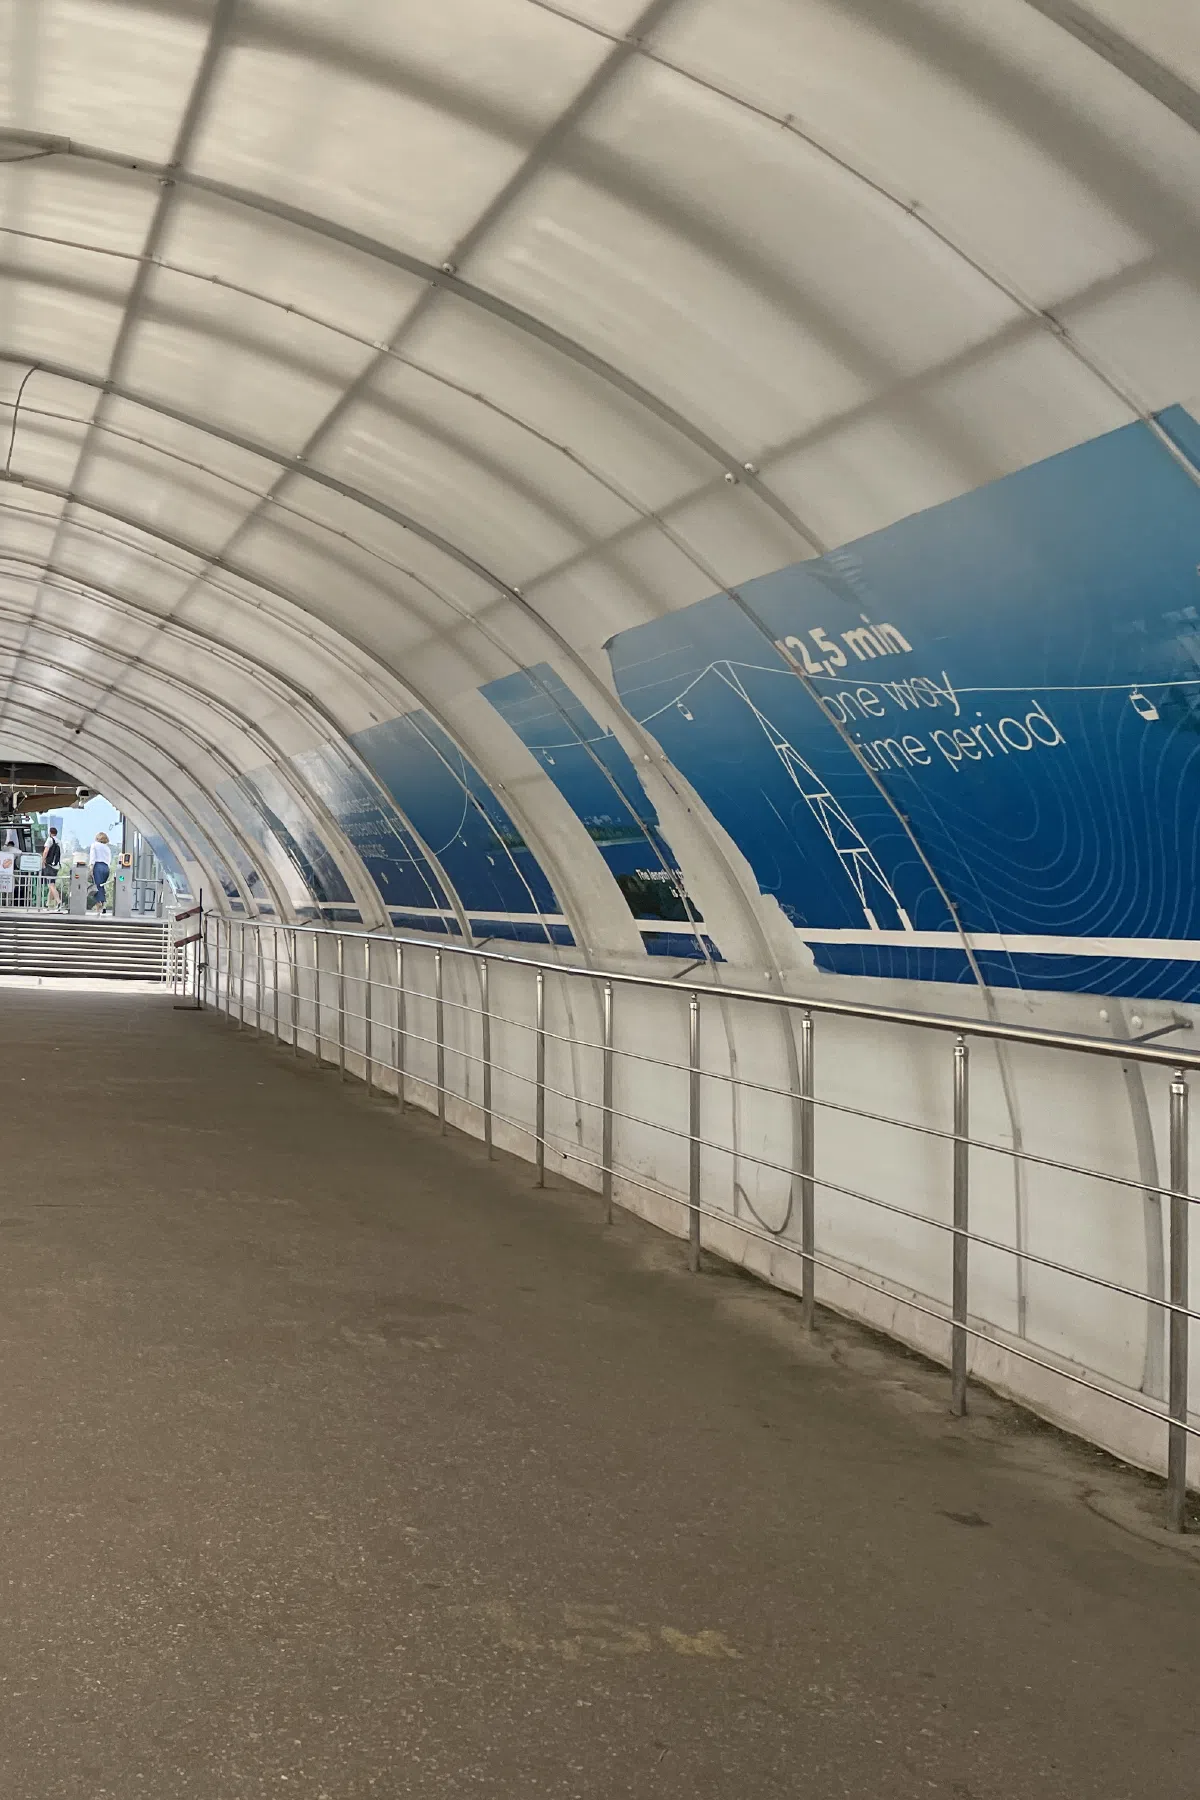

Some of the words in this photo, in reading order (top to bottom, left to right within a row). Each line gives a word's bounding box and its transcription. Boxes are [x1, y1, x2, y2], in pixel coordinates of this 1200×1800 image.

[841, 613, 913, 661] min
[820, 686, 885, 723] one
[880, 670, 960, 716] way
[929, 700, 1066, 772] period
